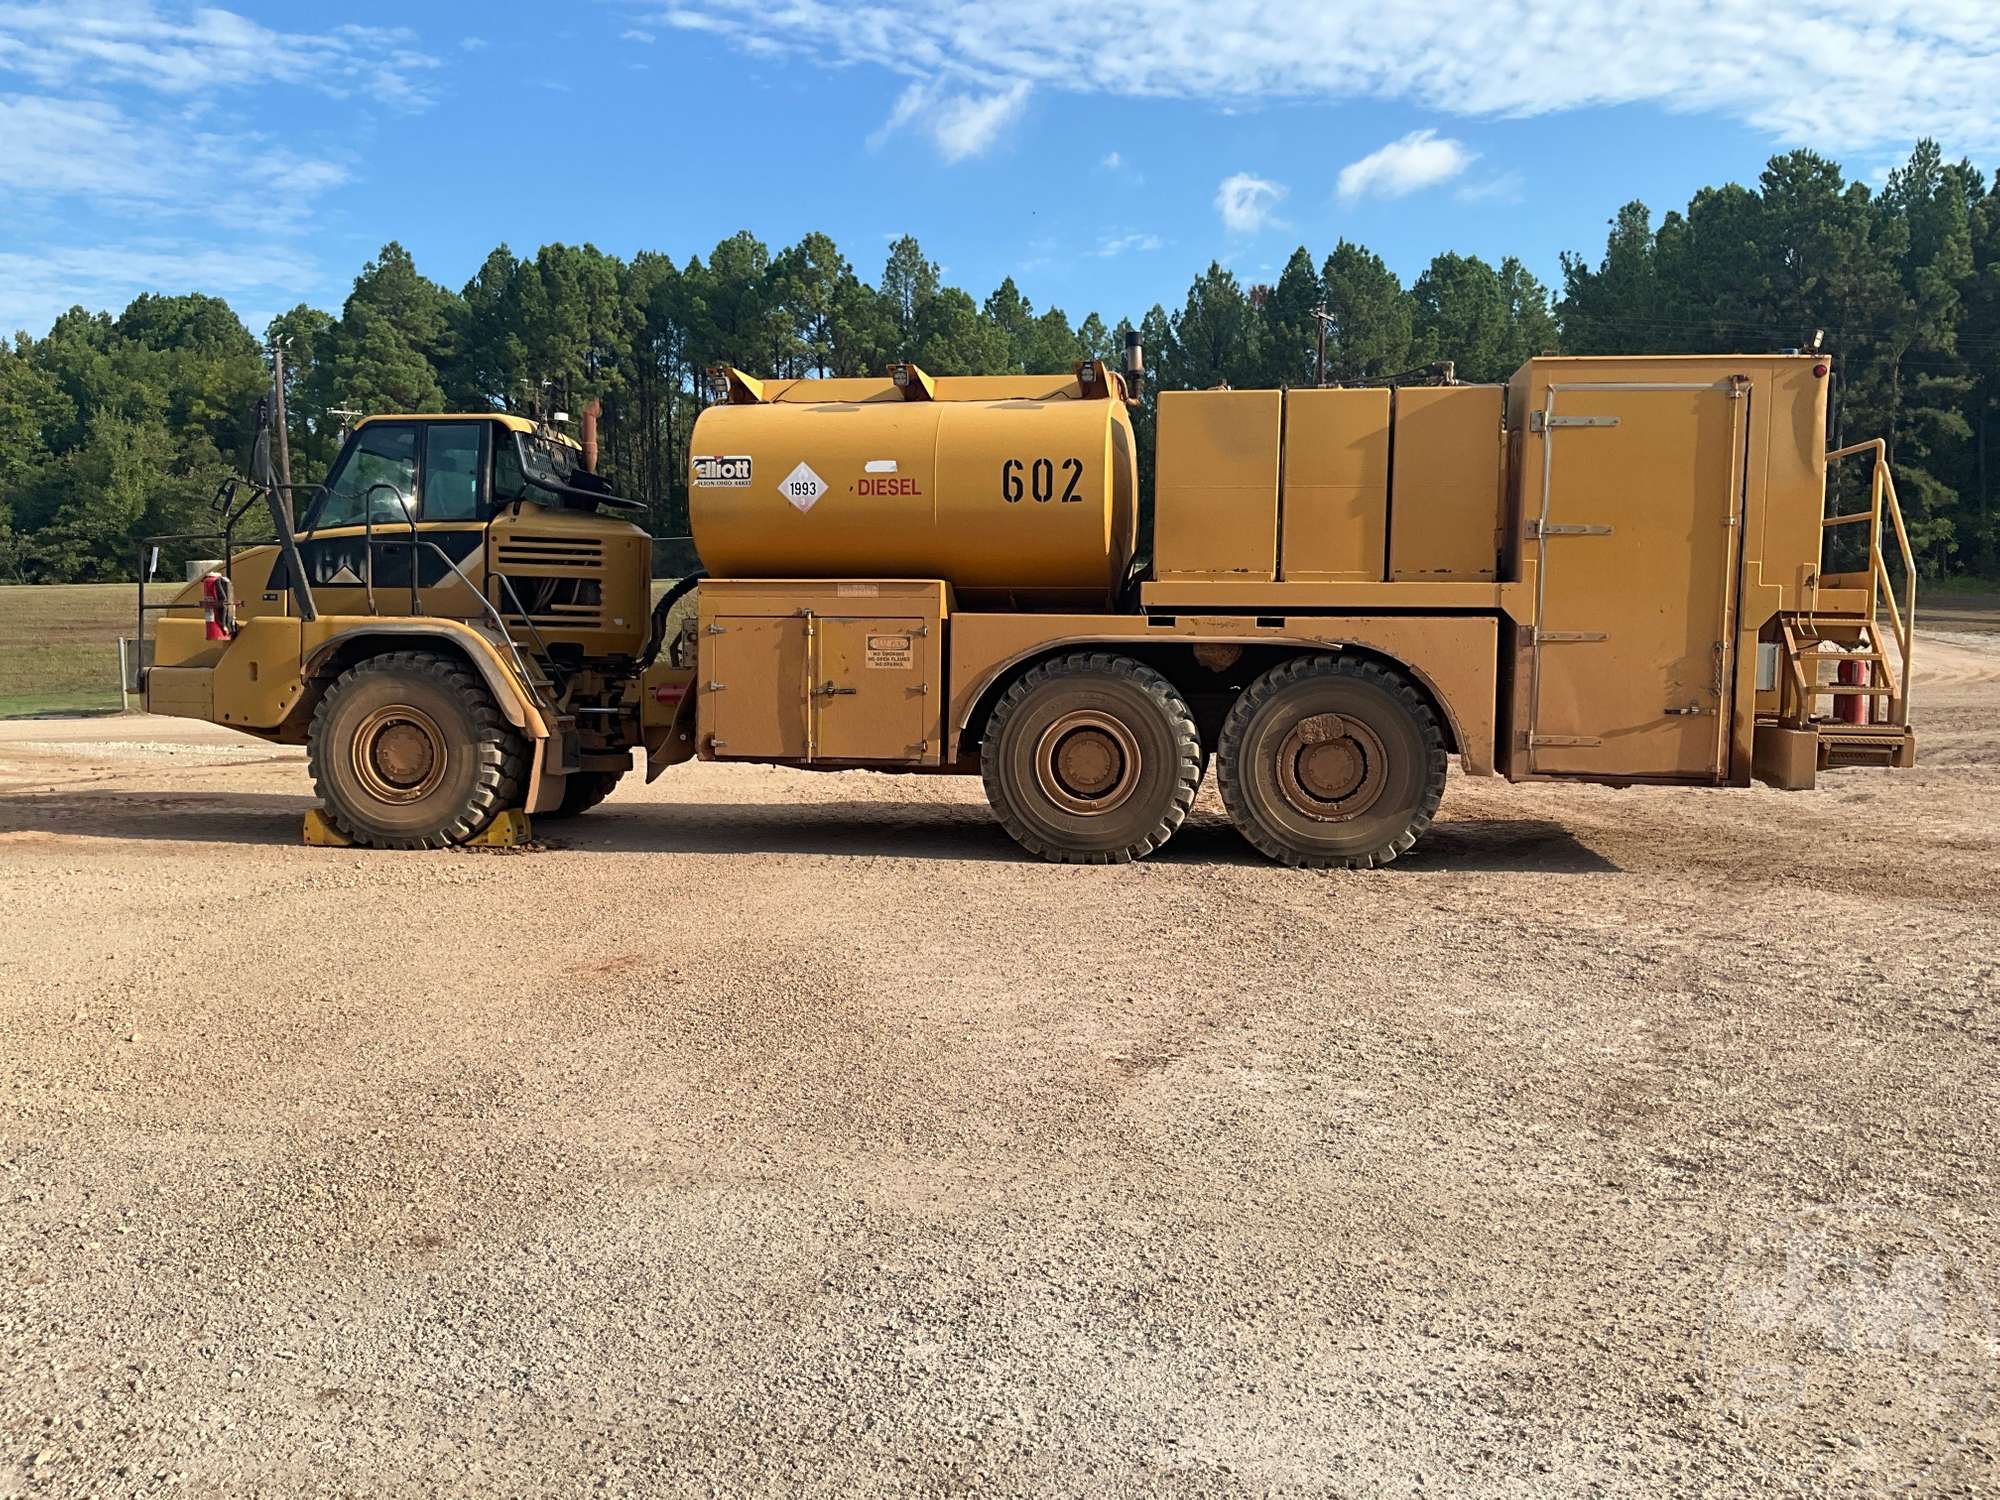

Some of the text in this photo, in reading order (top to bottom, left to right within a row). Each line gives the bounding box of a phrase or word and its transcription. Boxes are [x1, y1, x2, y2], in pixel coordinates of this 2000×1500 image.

[789, 481, 817, 496] 1993
[857, 478, 922, 496] DIESEL
[1002, 457, 1084, 503] 602
